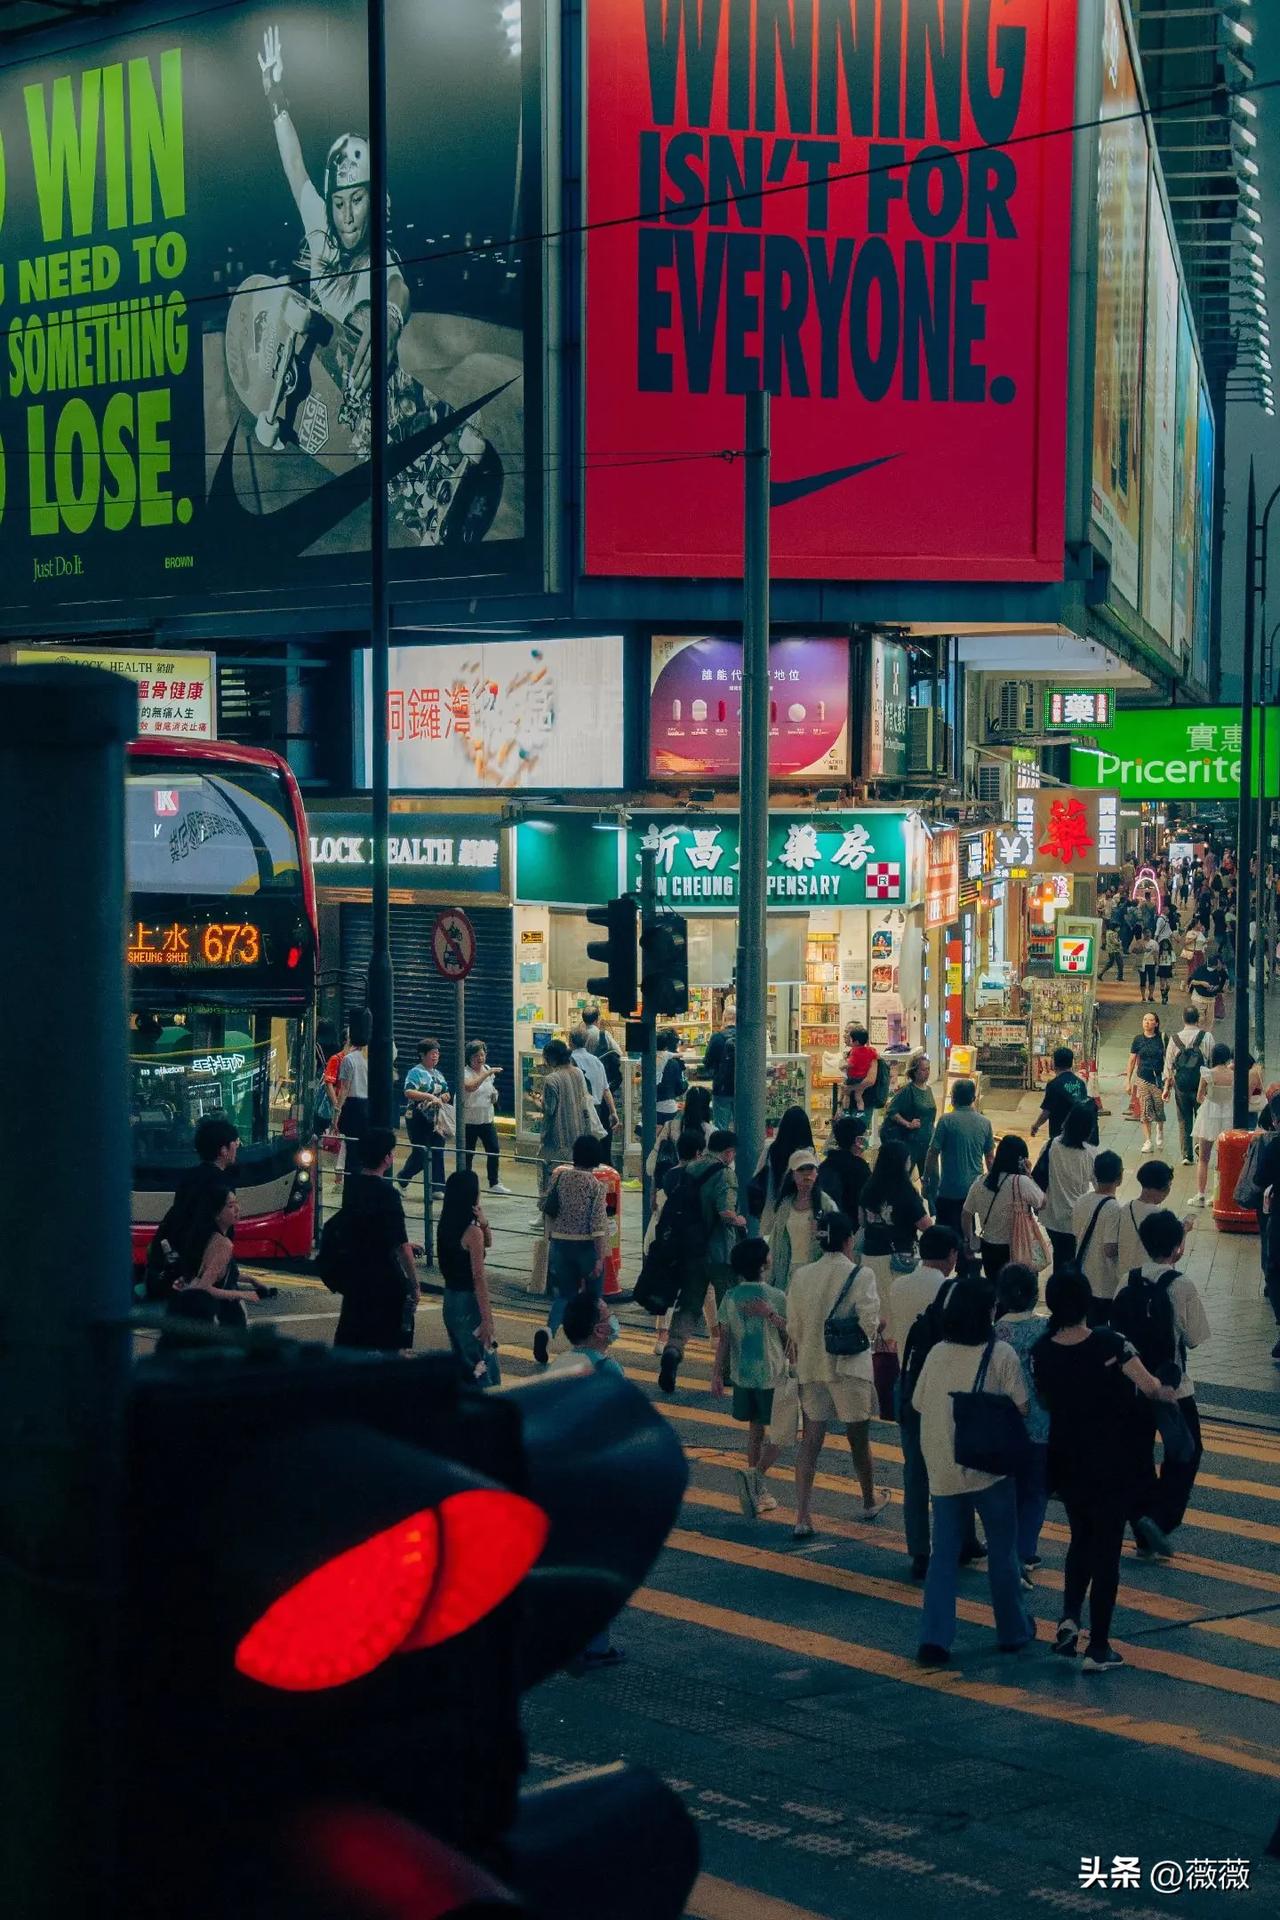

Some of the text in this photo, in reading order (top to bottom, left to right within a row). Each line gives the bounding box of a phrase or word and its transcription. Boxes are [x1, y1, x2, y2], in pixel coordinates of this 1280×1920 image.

[642, 0, 1027, 143] WINNING
[24, 48, 186, 243] WIN
[637, 131, 1018, 239] ISN'T FOR
[19, 243, 121, 304] NEED
[133, 231, 188, 284] TO
[637, 227, 1017, 405] EVERYONE.
[8, 289, 189, 400] SOMETHING
[300, 401, 317, 442] TAG
[27, 388, 193, 536] LOSE.
[33, 558, 54, 582] Just
[55, 556, 73, 576] Do
[164, 556, 194, 569] BROWN
[110, 662, 152, 673] HEALTH
[309, 837, 364, 863] LOCK
[369, 838, 454, 865] EALTH
[672, 875, 734, 896] CHEUNG
[129, 922, 190, 951] 上水
[204, 925, 260, 963] 673
[128, 952, 189, 963] SHEUNG SHUI
